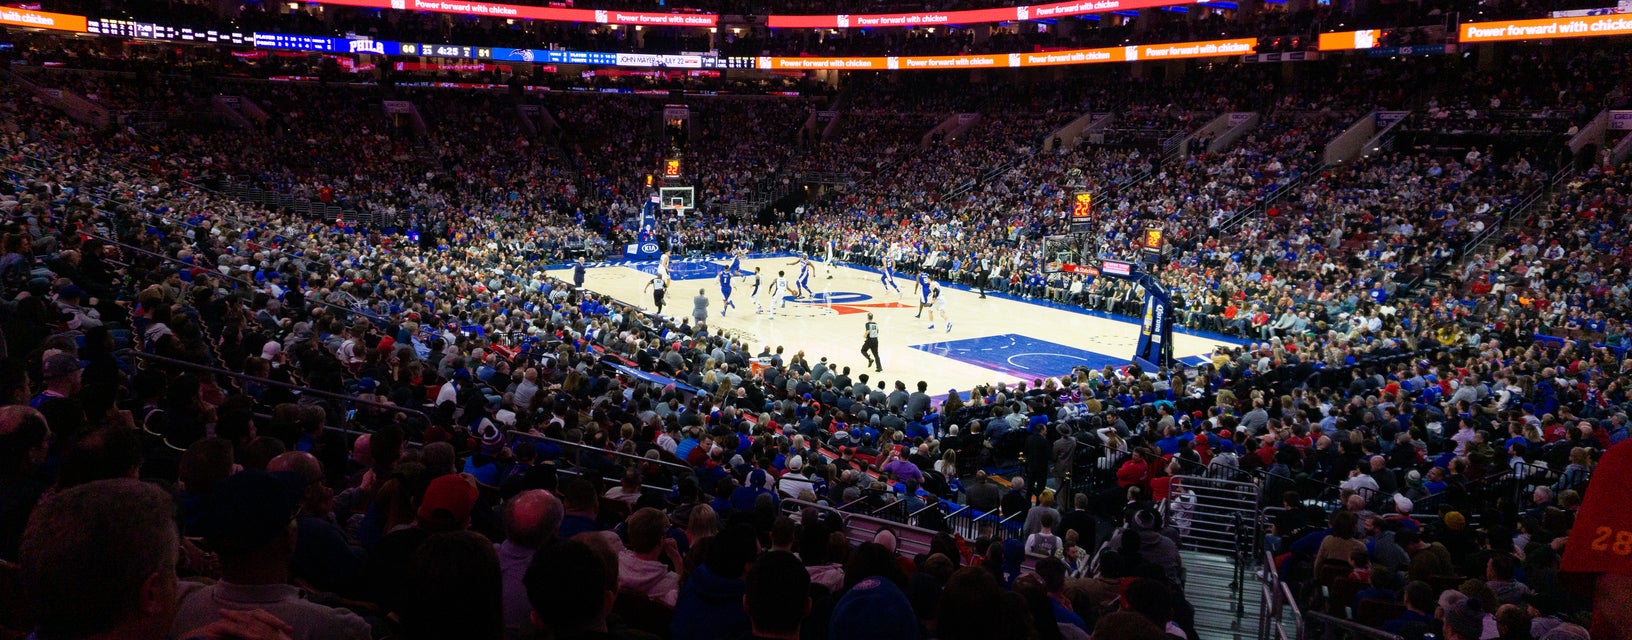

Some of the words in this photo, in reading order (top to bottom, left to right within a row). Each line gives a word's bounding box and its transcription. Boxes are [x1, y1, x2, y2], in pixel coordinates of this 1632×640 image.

[415, 0, 438, 9] Power
[440, 1, 471, 11] forward
[471, 3, 488, 13] with
[488, 4, 517, 15] chicken
[1036, 7, 1054, 16] Power
[1055, 5, 1079, 14] forward
[1079, 3, 1093, 12] with
[1094, 1, 1119, 11] chicken
[2, 11, 21, 22] with
[22, 13, 54, 25] chicken
[617, 14, 639, 22] Power
[640, 14, 668, 23] forward
[668, 14, 684, 23] with
[685, 15, 712, 24] chicken
[858, 17, 880, 25] Power
[880, 16, 906, 24] forward
[906, 15, 921, 23] with
[922, 14, 948, 23] chicken
[1467, 26, 1506, 38] Power
[1507, 22, 1556, 36] forward
[1559, 20, 1588, 33] with
[1590, 17, 1632, 31] chicke
[349, 40, 385, 54] PHILA
[402, 44, 415, 53] 60
[437, 46, 459, 56] 4:25
[478, 48, 489, 57] 51
[1146, 47, 1169, 57] Power
[1169, 46, 1199, 56] forward
[1200, 44, 1218, 54] with
[1218, 42, 1250, 53] chicken
[780, 59, 802, 67] Power
[802, 59, 829, 67] forward
[829, 59, 845, 67] with
[846, 59, 872, 67] chicken
[907, 58, 927, 66] Power
[928, 58, 954, 66] forward
[955, 57, 969, 65] with
[969, 57, 994, 65] chicken
[1028, 55, 1047, 63] Power
[1047, 53, 1070, 63] forward
[1071, 53, 1085, 61] with
[1085, 51, 1110, 60] chicken
[667, 165, 677, 175] 22
[1075, 202, 1089, 216] 22
[1148, 237, 1158, 246] 22
[1155, 303, 1164, 333] Corona
[1591, 526, 1632, 556] 28
